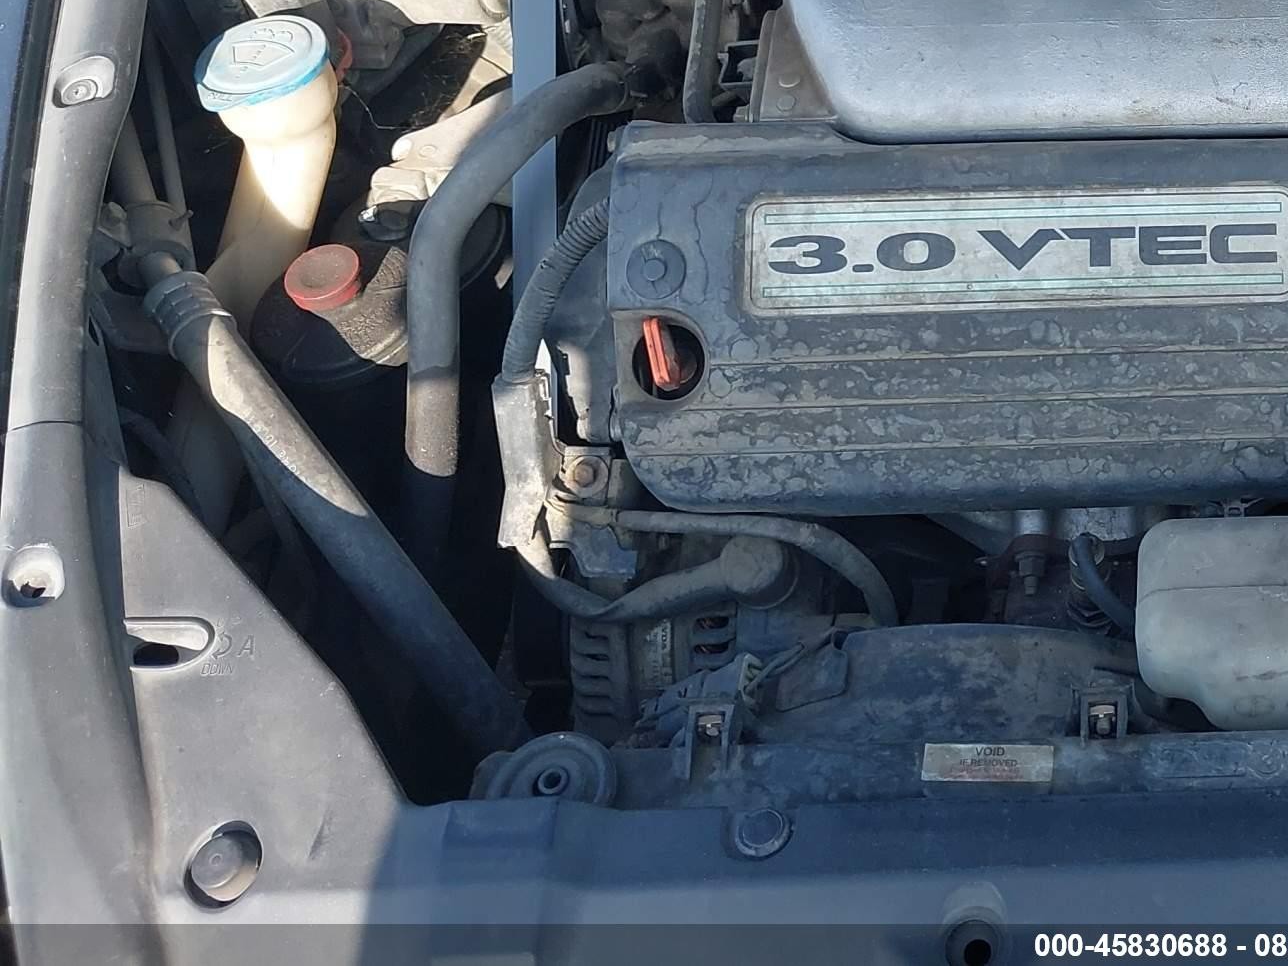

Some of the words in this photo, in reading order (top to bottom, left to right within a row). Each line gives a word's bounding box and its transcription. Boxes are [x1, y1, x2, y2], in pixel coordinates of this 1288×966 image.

[768, 232, 956, 274] 3.0
[976, 223, 1278, 270] VTEC
[975, 747, 1005, 756] VOID
[972, 759, 1018, 767] REMOVED
